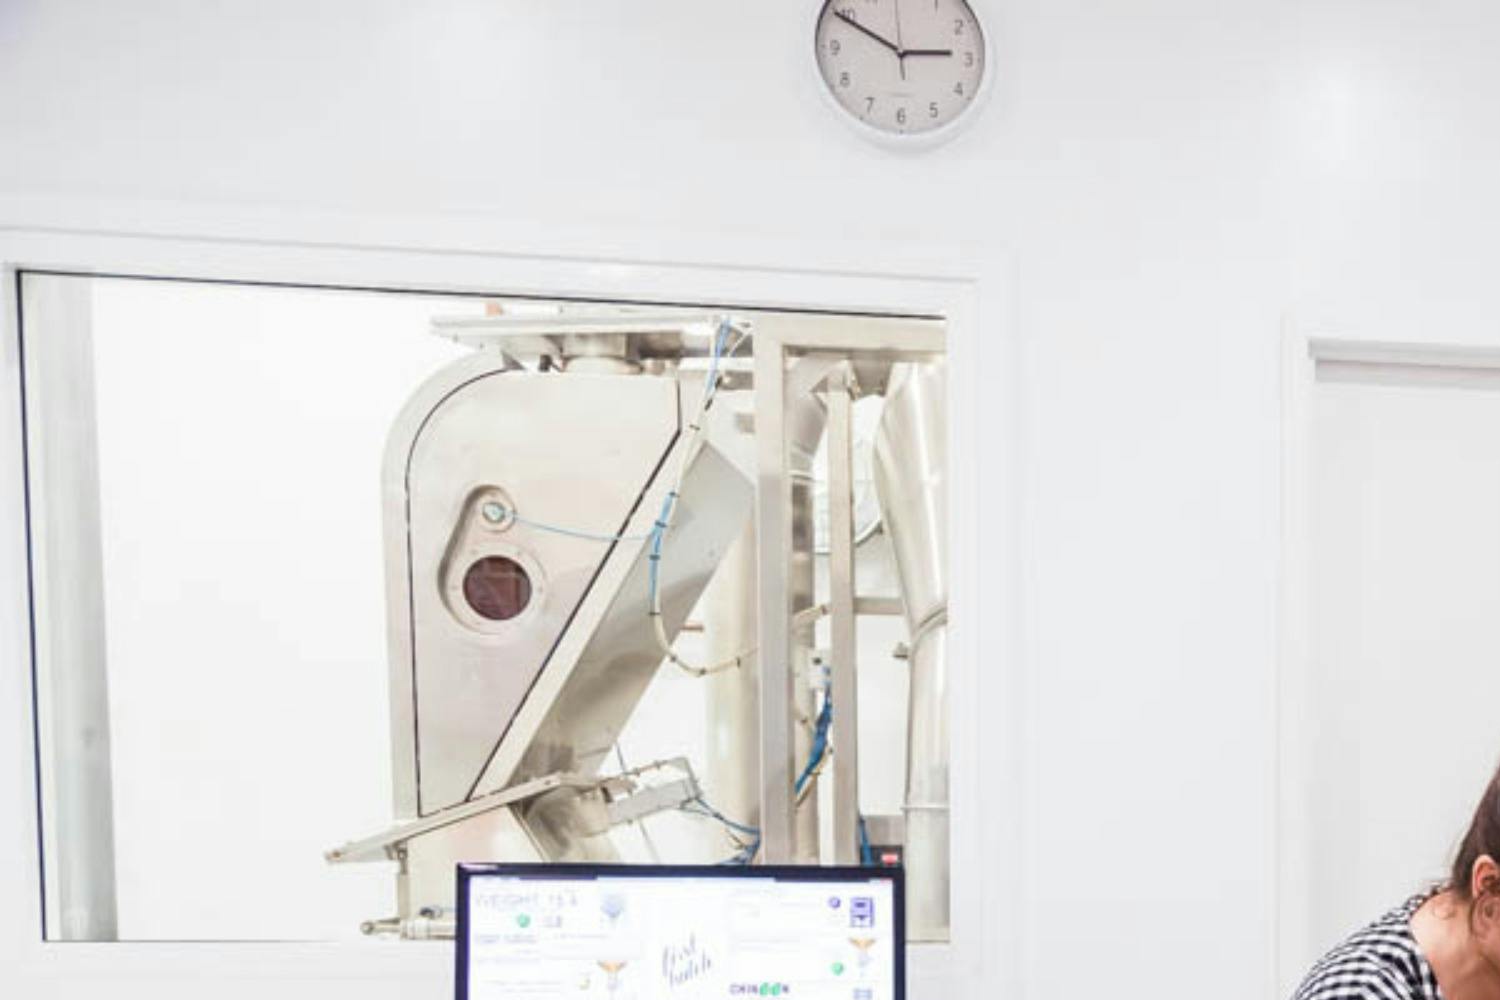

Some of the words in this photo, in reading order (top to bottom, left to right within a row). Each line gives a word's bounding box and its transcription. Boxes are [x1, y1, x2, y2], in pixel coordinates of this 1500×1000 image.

[954, 19, 964, 35] 2
[829, 39, 840, 56] 9
[964, 53, 973, 67] 3
[840, 72, 850, 87] 8
[953, 82, 963, 96] 4
[866, 97, 875, 113] 7
[929, 102, 939, 119] 5
[896, 107, 906, 124] 6
